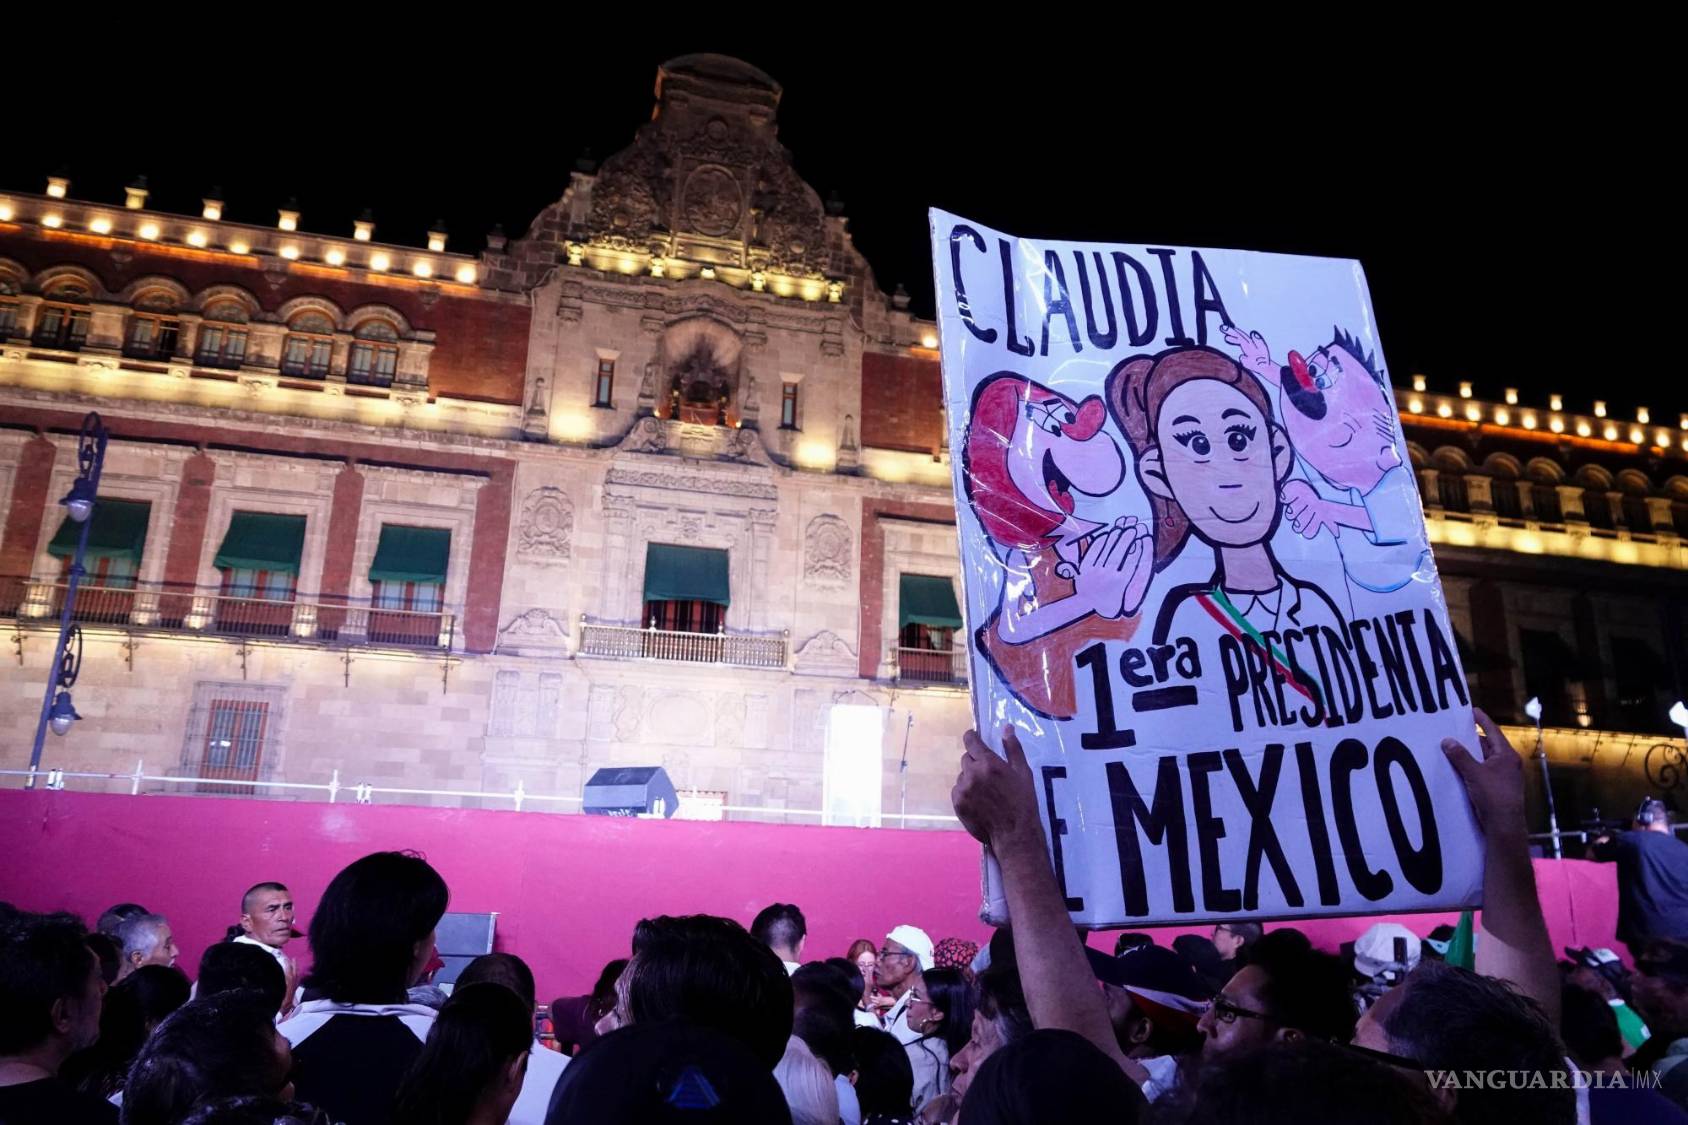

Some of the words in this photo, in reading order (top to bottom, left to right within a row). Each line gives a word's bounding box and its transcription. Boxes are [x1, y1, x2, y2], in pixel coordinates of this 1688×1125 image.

[950, 225, 1234, 357] CLAUDIA
[1219, 608, 1469, 732] PRESIDENTA
[1106, 737, 1443, 916] MEXICO
